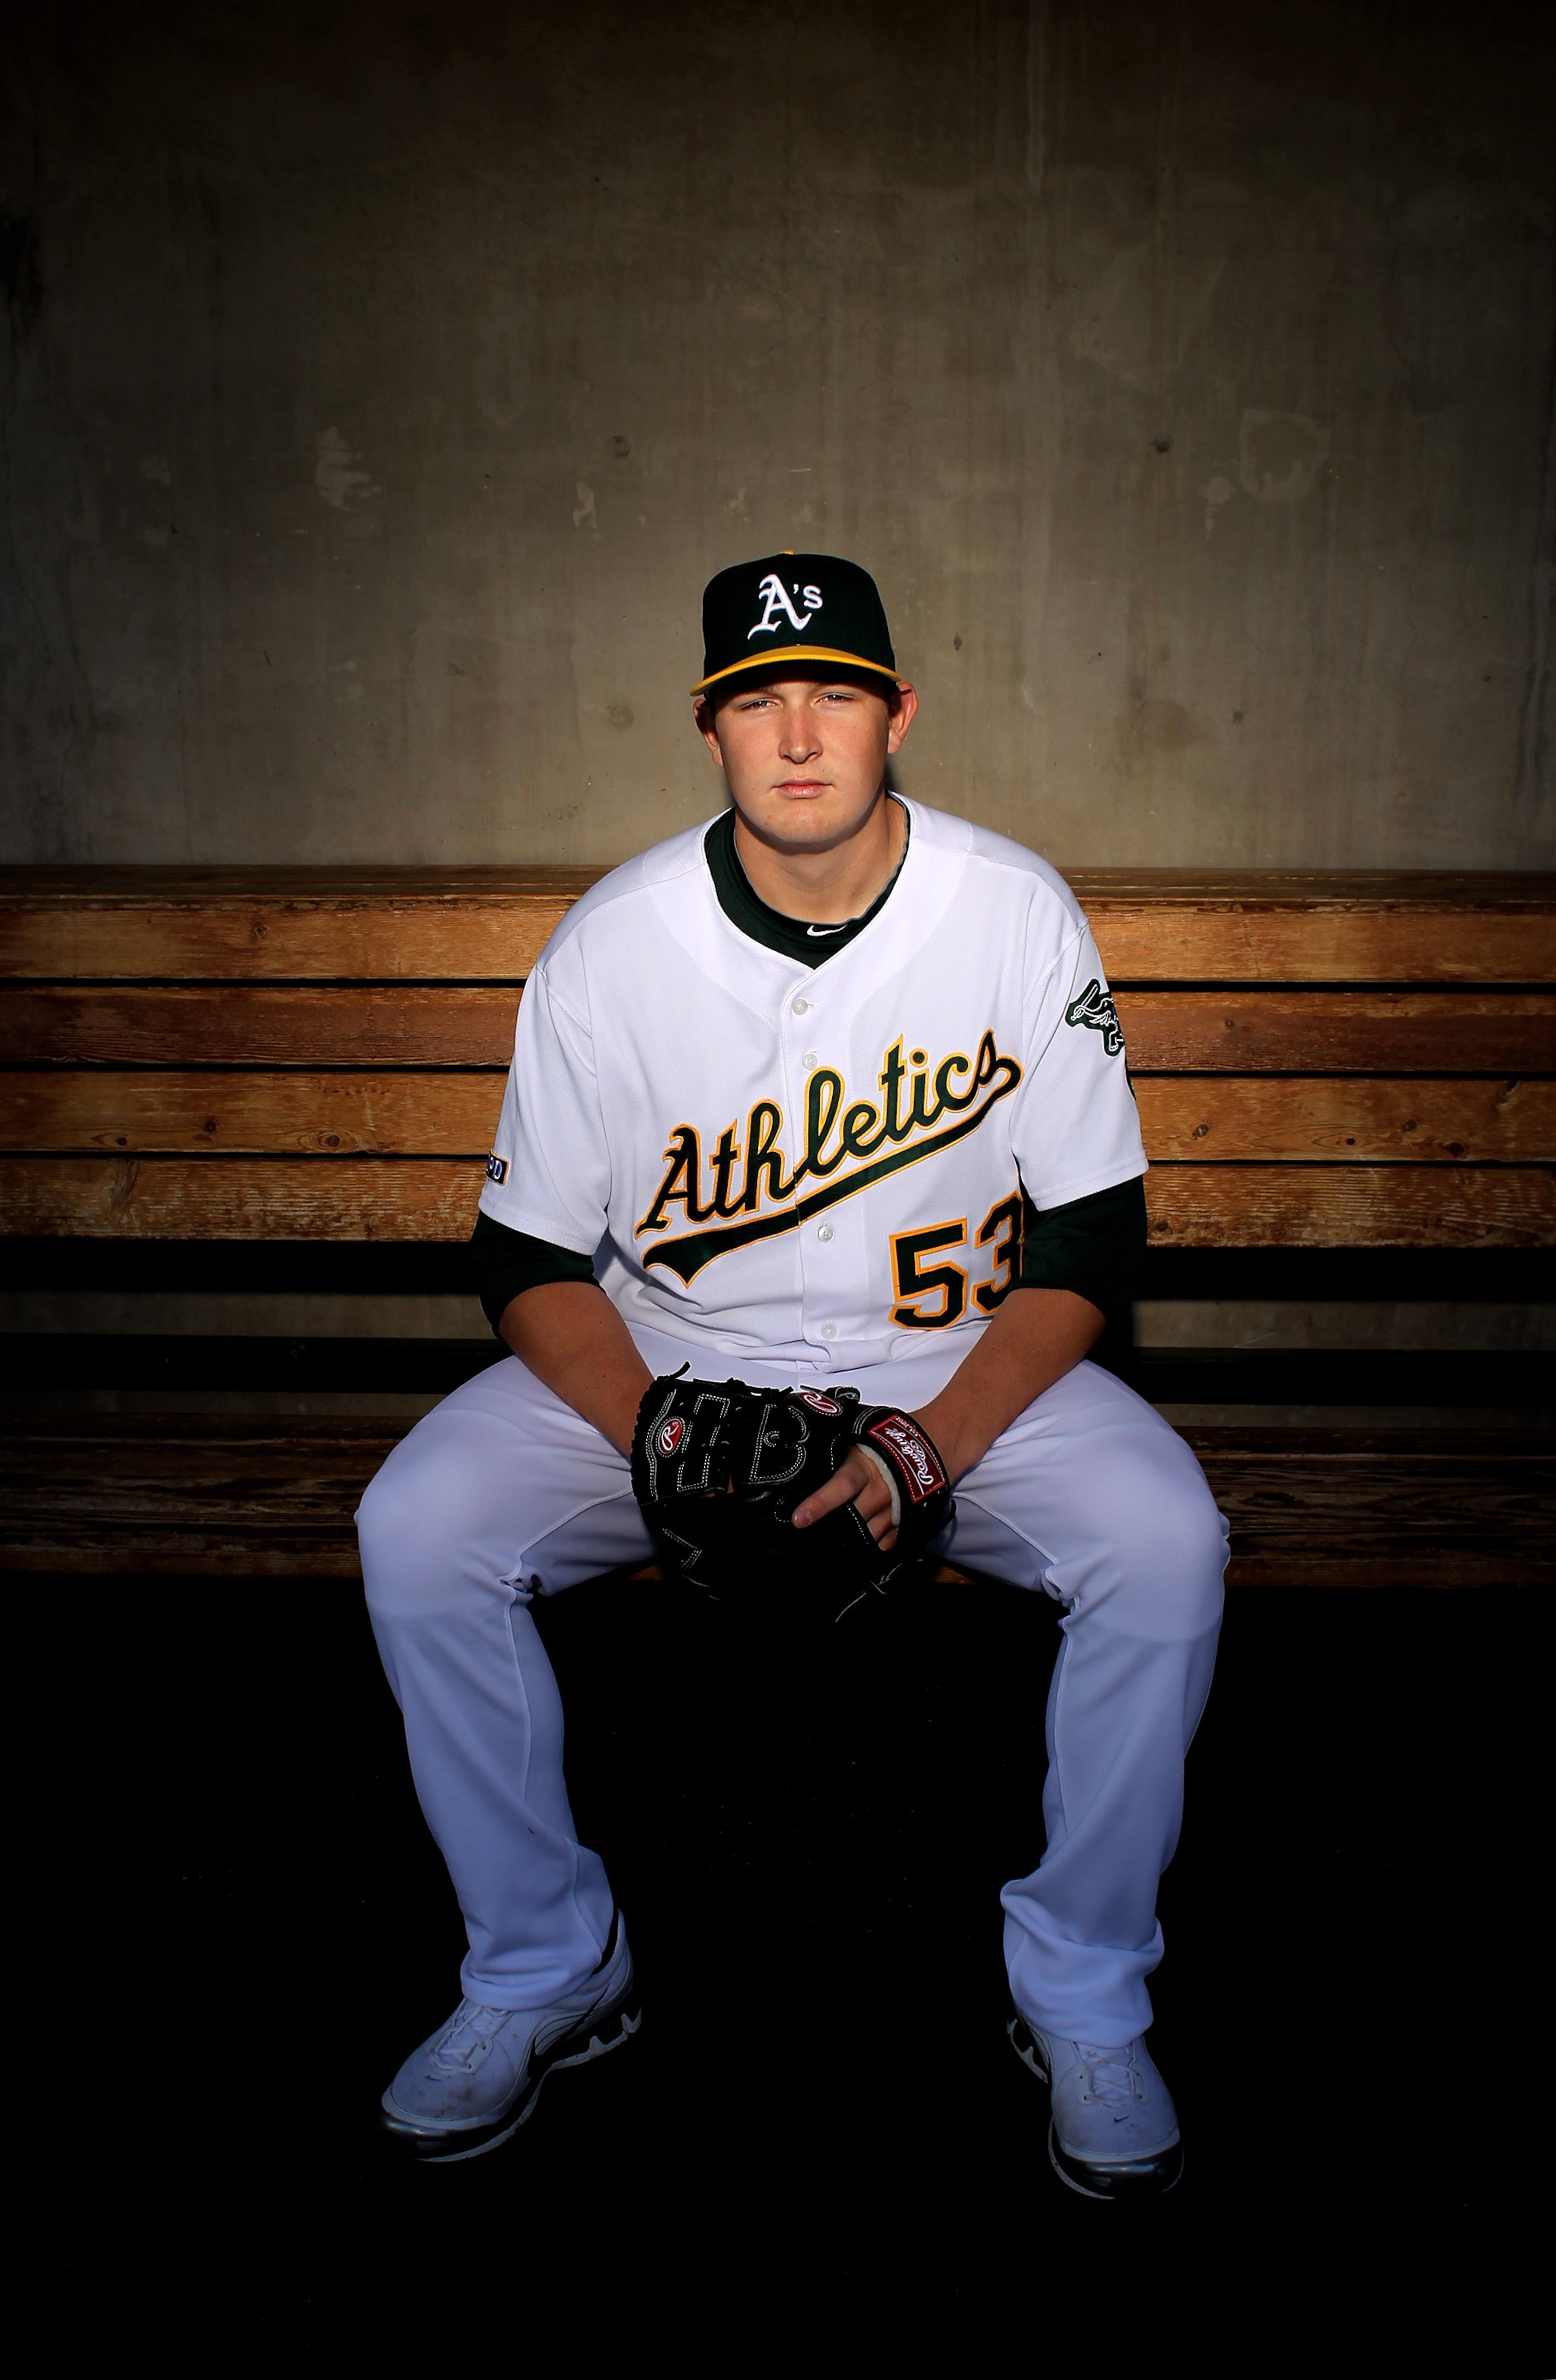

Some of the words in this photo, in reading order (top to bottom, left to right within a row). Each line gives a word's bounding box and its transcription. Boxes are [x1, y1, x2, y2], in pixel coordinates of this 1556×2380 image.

[748, 574, 823, 640] A's
[635, 1028, 1024, 1239] Athletics
[888, 1190, 1024, 1330] 53
[885, 1427, 934, 1485] Rawlings
